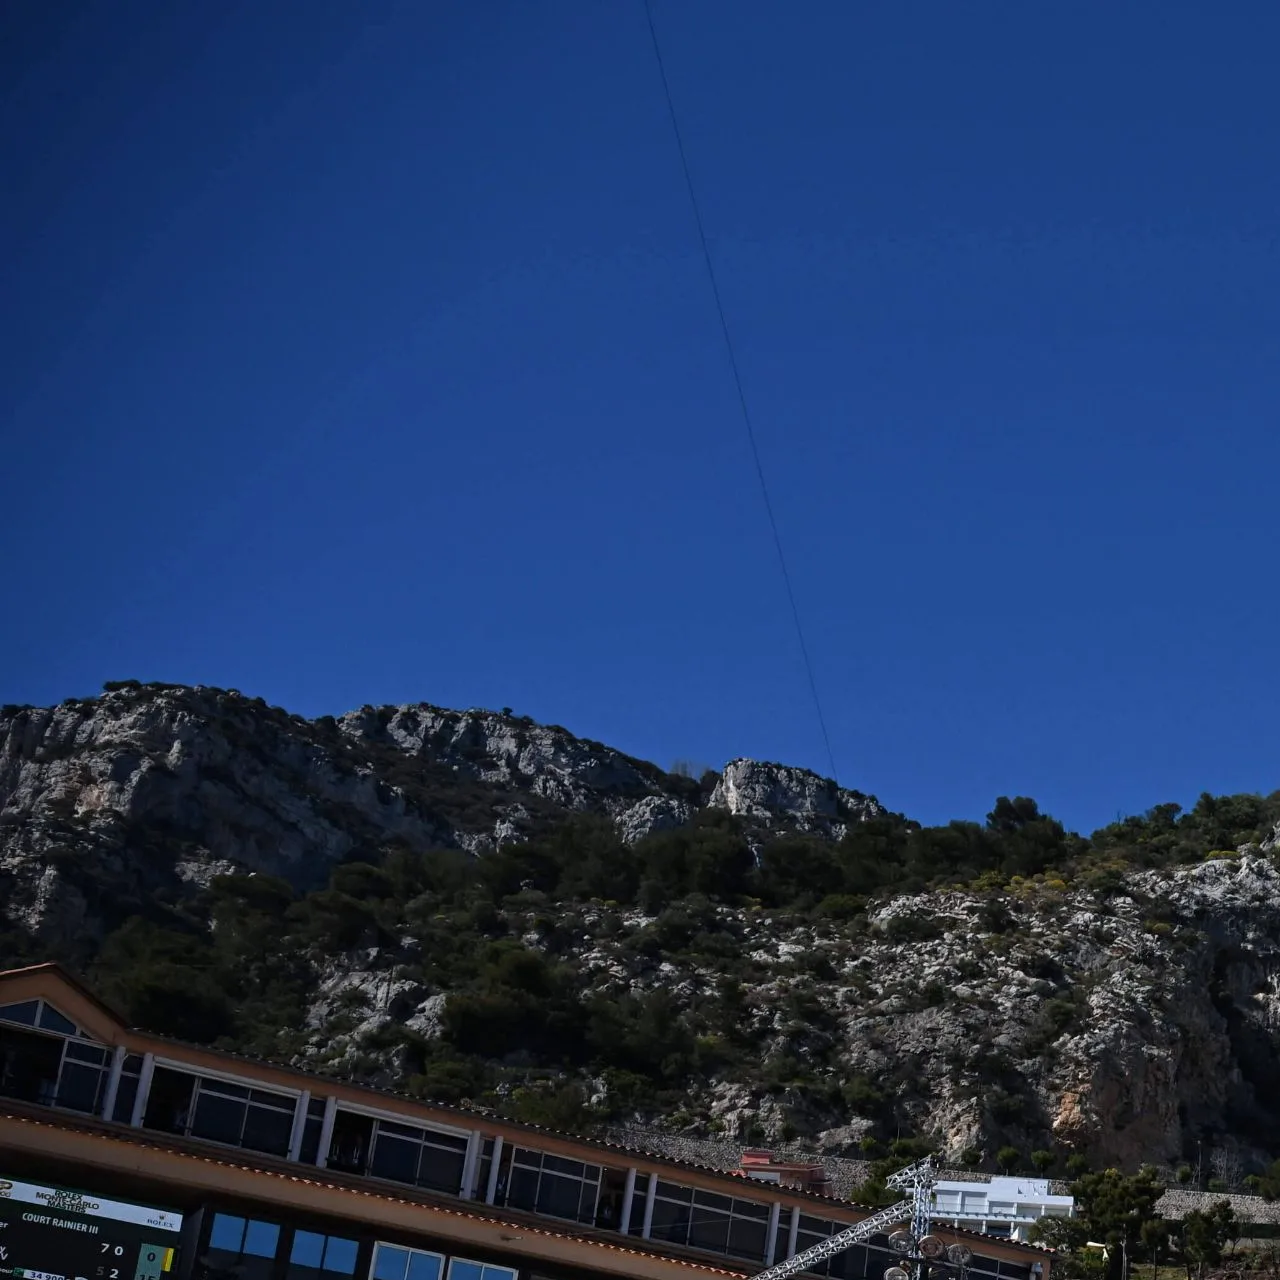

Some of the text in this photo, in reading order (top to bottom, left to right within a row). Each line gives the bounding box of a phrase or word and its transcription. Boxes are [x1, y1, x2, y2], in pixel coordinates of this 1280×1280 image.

[22, 1212, 51, 1226] COURT
[52, 1218, 87, 1232] RAINIER
[89, 1225, 99, 1235] III
[101, 1243, 156, 1262] 7 0 0
[30, 1271, 43, 1280] 34
[109, 1269, 119, 1279] 2
